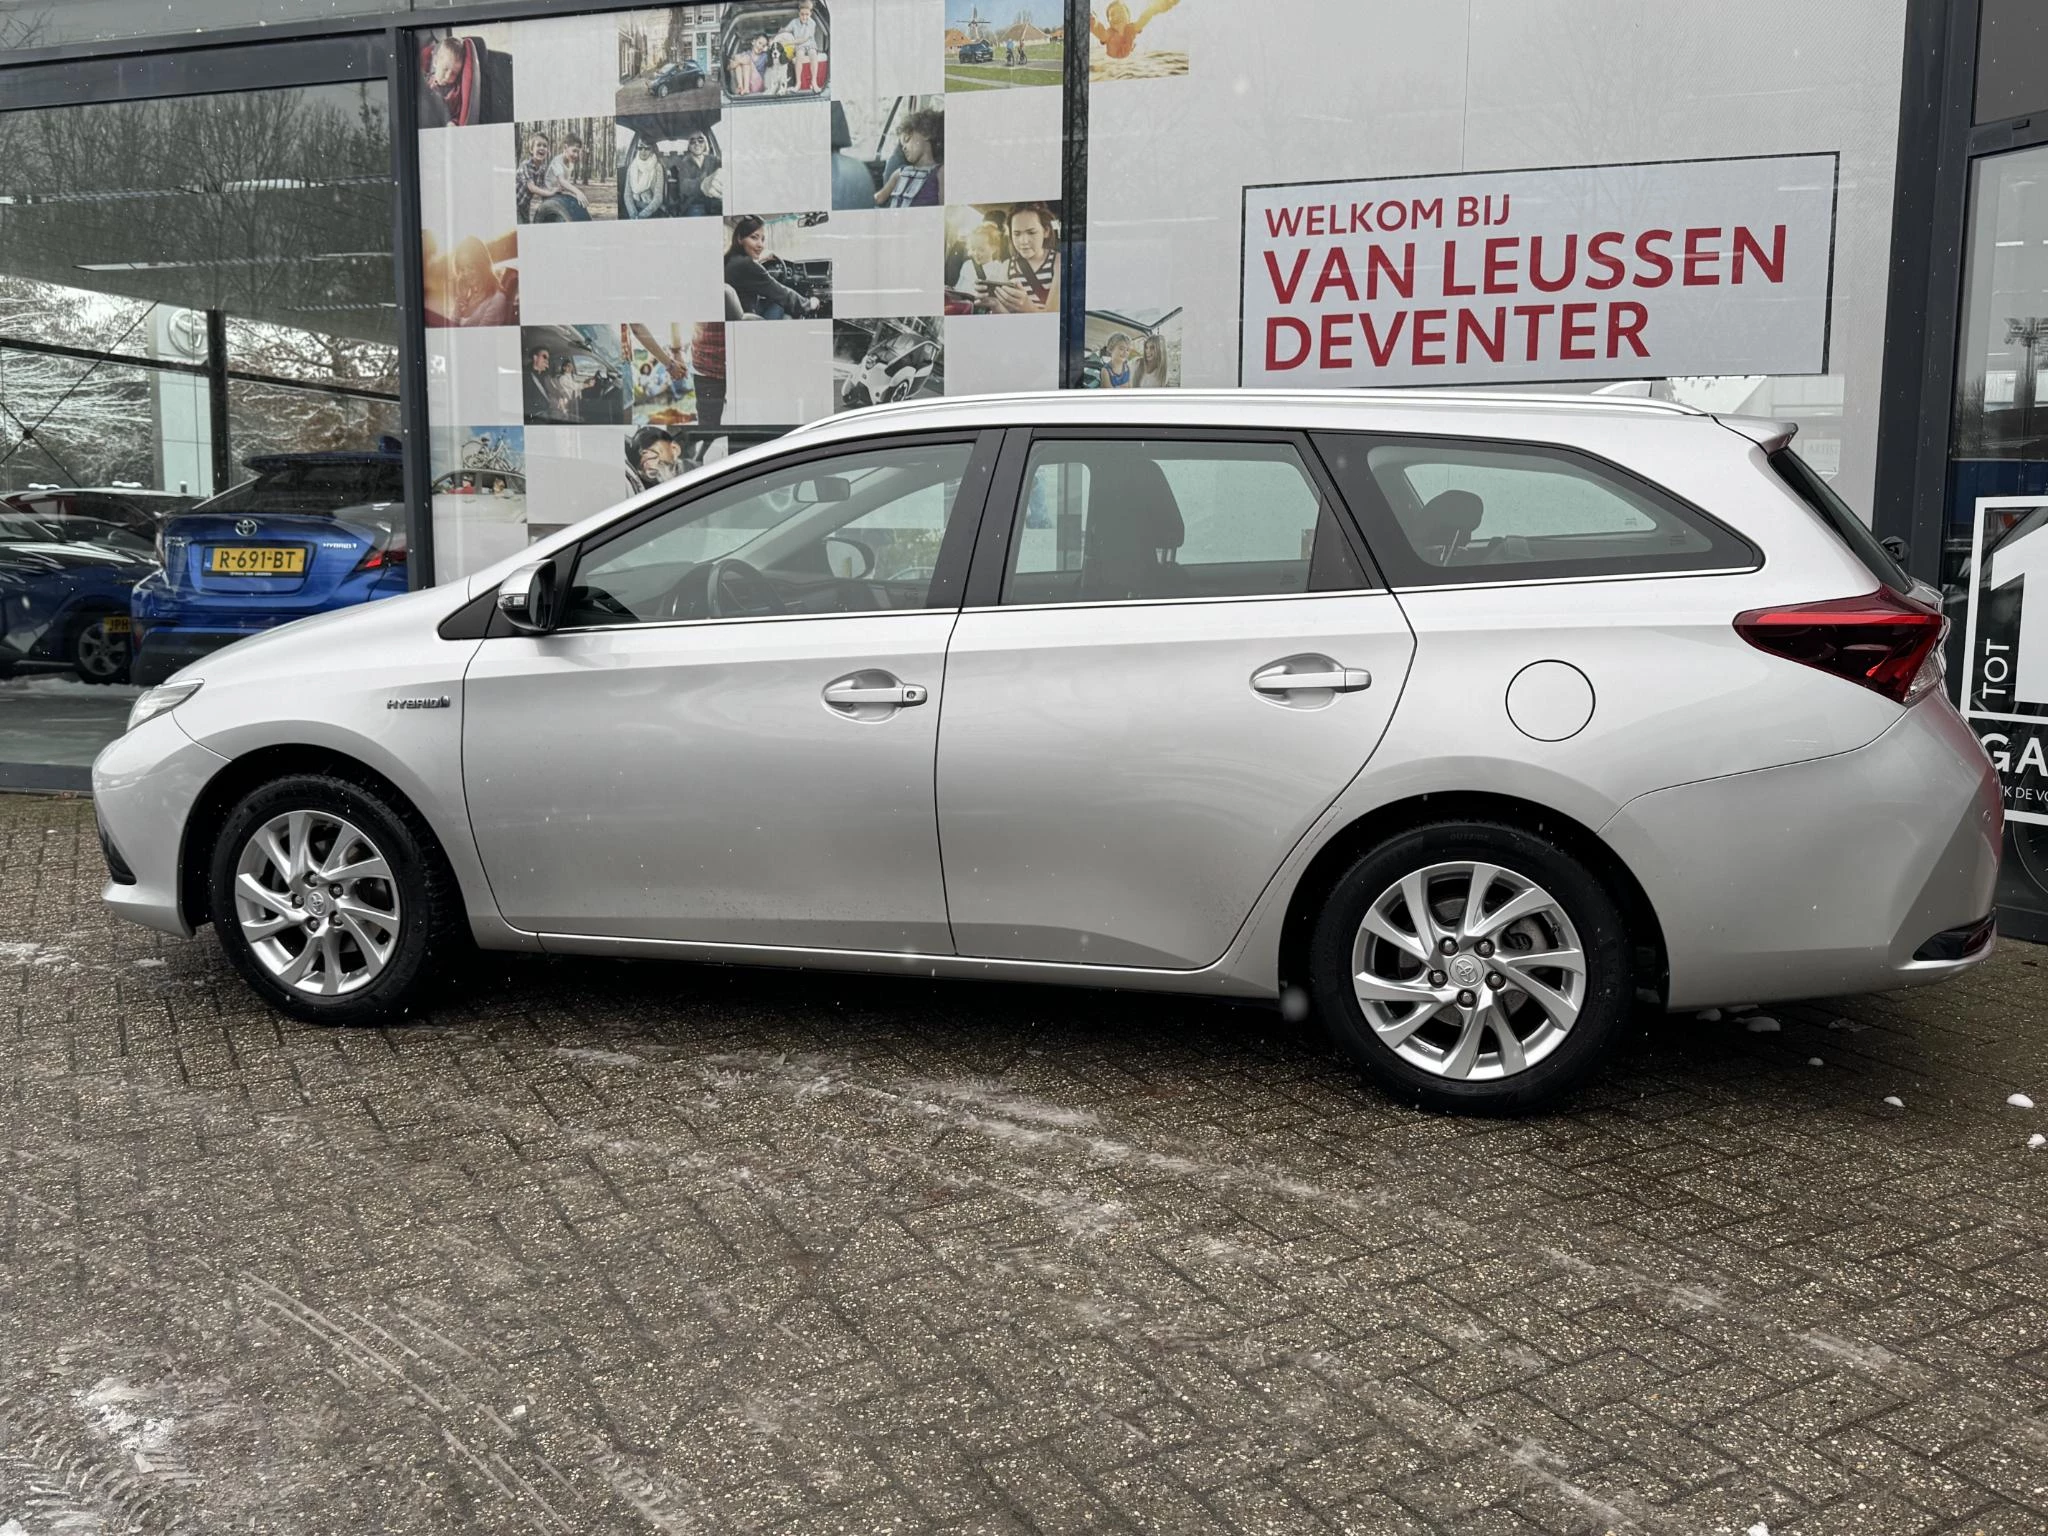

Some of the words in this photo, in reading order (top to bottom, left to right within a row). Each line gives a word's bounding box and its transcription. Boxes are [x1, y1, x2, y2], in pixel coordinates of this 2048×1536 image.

[1265, 197, 1444, 238] WELKOM
[1457, 194, 1510, 228] BIJ
[1264, 243, 1415, 305] VAN
[1442, 225, 1787, 297] LEUSSEN
[1265, 301, 1651, 372] DEVENTER
[219, 551, 296, 569] R-691-BT
[1982, 638, 2010, 699] TOT
[2015, 787, 2033, 800] DE
